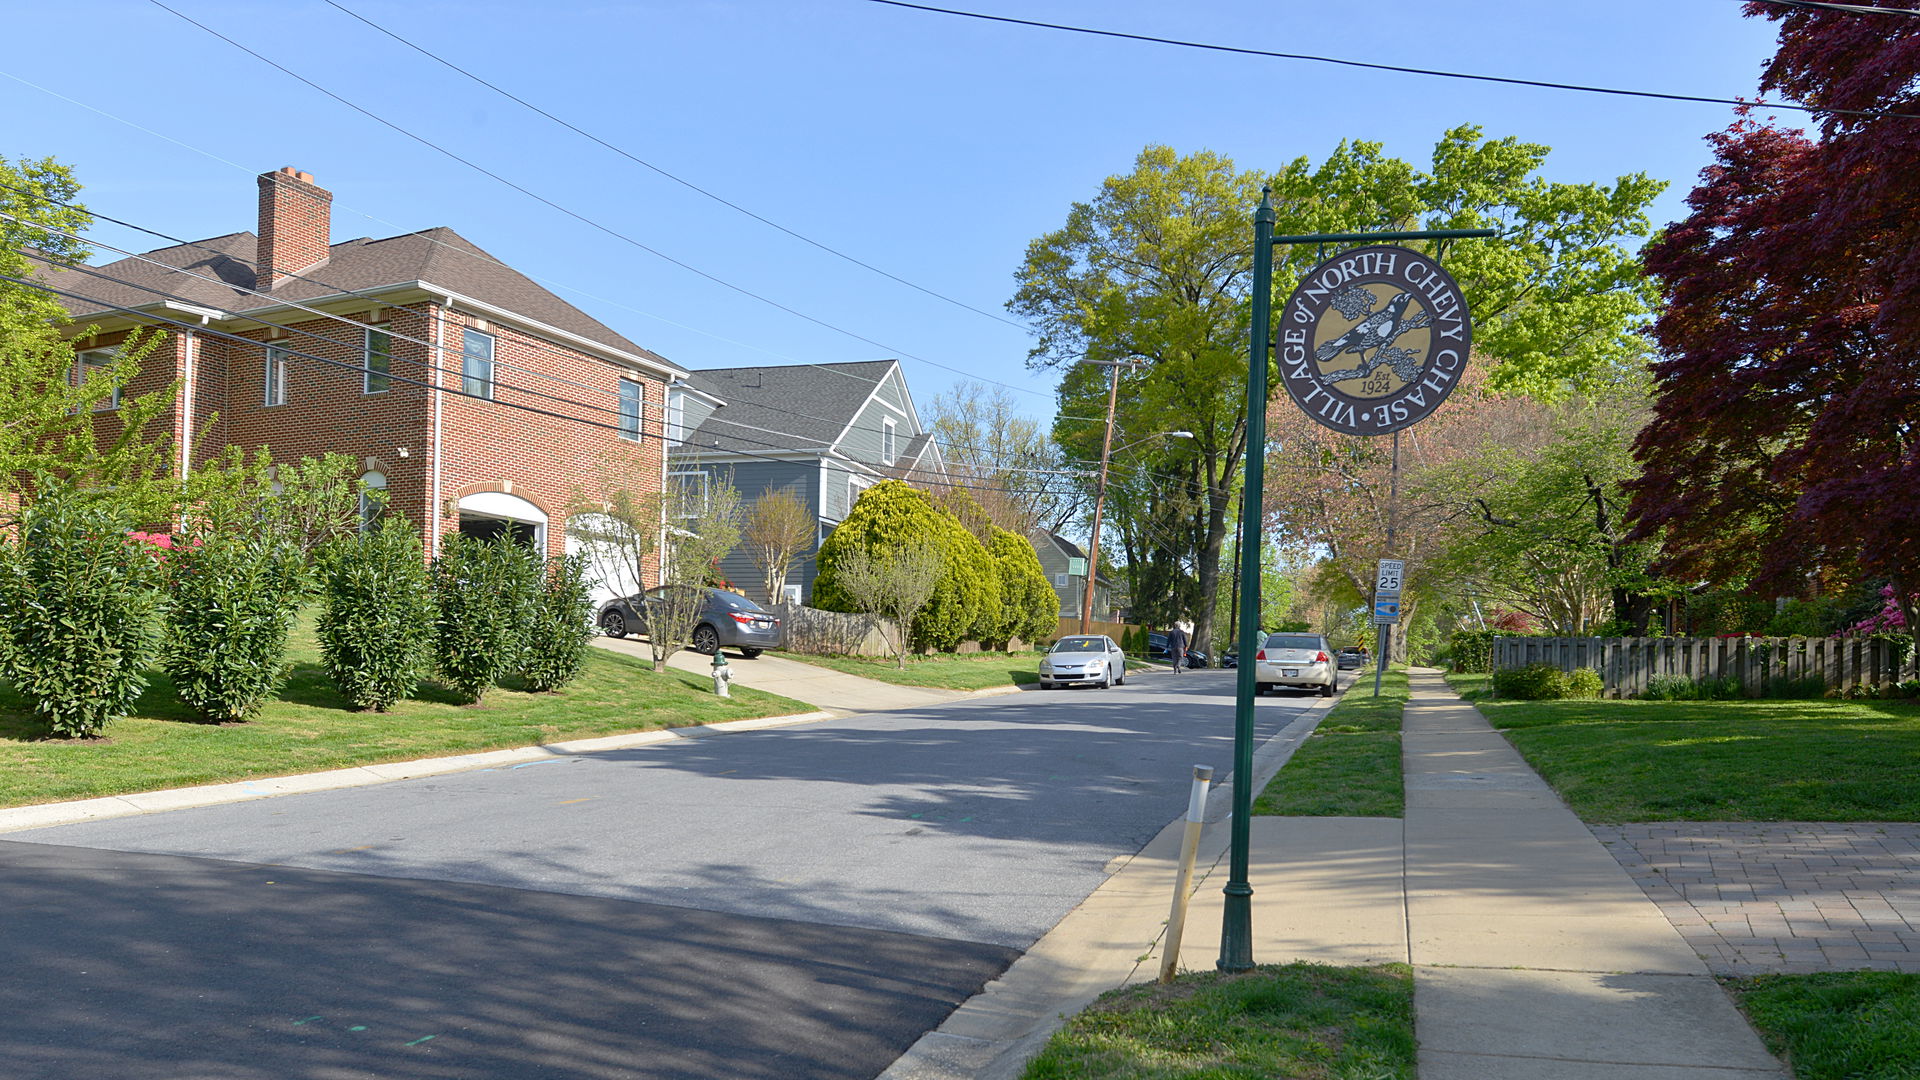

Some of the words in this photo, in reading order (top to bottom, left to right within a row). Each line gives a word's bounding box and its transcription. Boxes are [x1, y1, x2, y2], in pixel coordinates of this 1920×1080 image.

[1303, 253, 1398, 306] NORTH
[1404, 261, 1464, 343] CHEVY
[1293, 297, 1315, 324] of
[1284, 328, 1357, 428] VILLAGE
[1360, 380, 1391, 395] 1924
[1373, 349, 1459, 428] CHASE
[1379, 577, 1399, 588] 25
